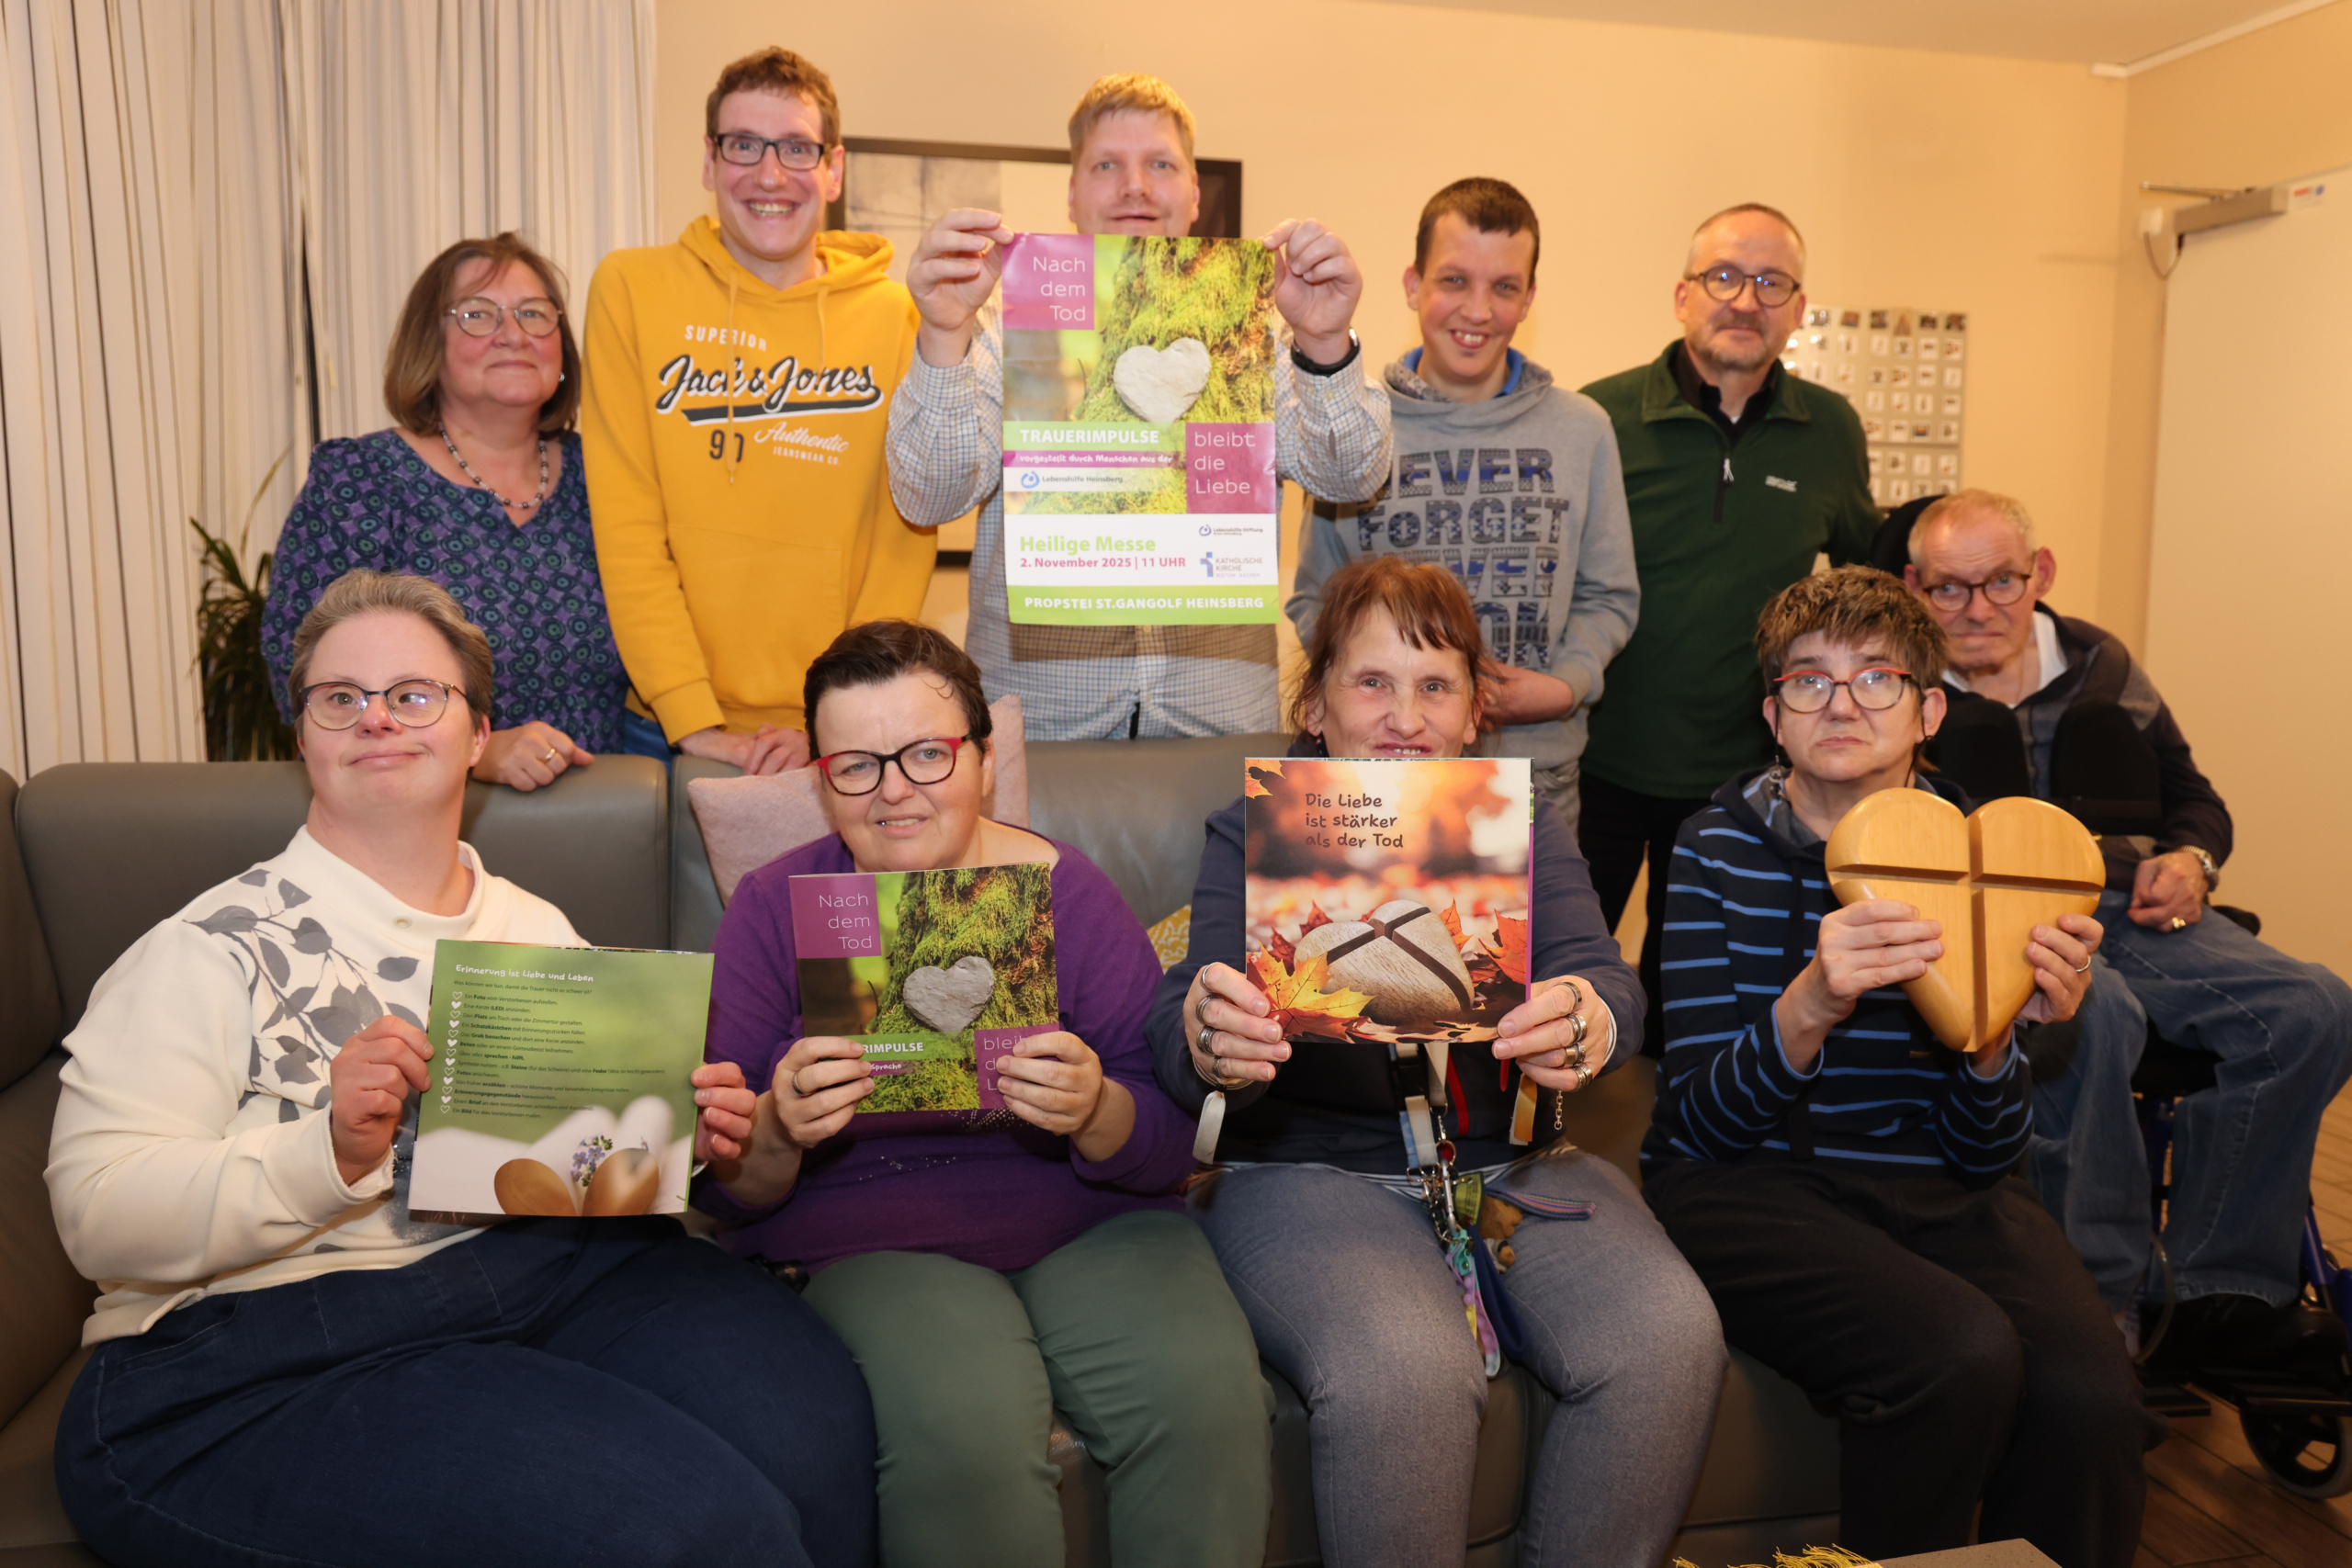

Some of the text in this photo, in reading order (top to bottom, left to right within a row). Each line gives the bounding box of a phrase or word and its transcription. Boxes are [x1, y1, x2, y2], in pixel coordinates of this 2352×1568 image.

[1033, 256, 1086, 273] Nach
[1040, 281, 1086, 297] dem
[1049, 305, 1086, 321] Tod
[684, 324, 767, 352] SUPERIOR
[754, 421, 849, 453] Authentic
[1020, 429, 1159, 445] TRAUERIMPULSE
[1194, 432, 1256, 447] bleibt
[1020, 454, 1066, 464] vorgestellt
[1069, 454, 1093, 463] durch
[1095, 454, 1138, 463] Menschen
[1158, 454, 1173, 463] der
[1194, 455, 1225, 471] die
[1086, 476, 1123, 484] Heinsberg
[1195, 479, 1251, 494] Liebe
[1357, 497, 1569, 551] FORGET
[1020, 536, 1156, 556] Heilige Messe
[1020, 558, 1032, 568] 2.
[1035, 558, 1098, 568] November
[1102, 558, 1132, 568] 2025
[1142, 558, 1155, 568] 11
[1159, 558, 1186, 568] UHR
[1024, 597, 1264, 609] PROPSTEI ST.GANGOLF HEINSBERG
[1306, 793, 1383, 808] Die Liebe
[1306, 812, 1397, 829] ist stärker
[1306, 833, 1403, 848] als der Tod
[819, 893, 868, 908] Nach
[828, 916, 871, 930] dem
[838, 935, 872, 950] Tod
[456, 964, 505, 977] Erinnerung
[508, 969, 520, 977] ist
[523, 970, 546, 979] Liebe
[568, 973, 594, 982] Leben
[862, 1042, 924, 1054] RIMPULSE
[984, 1035, 1025, 1050] blei
[870, 1063, 902, 1071] Sprache
